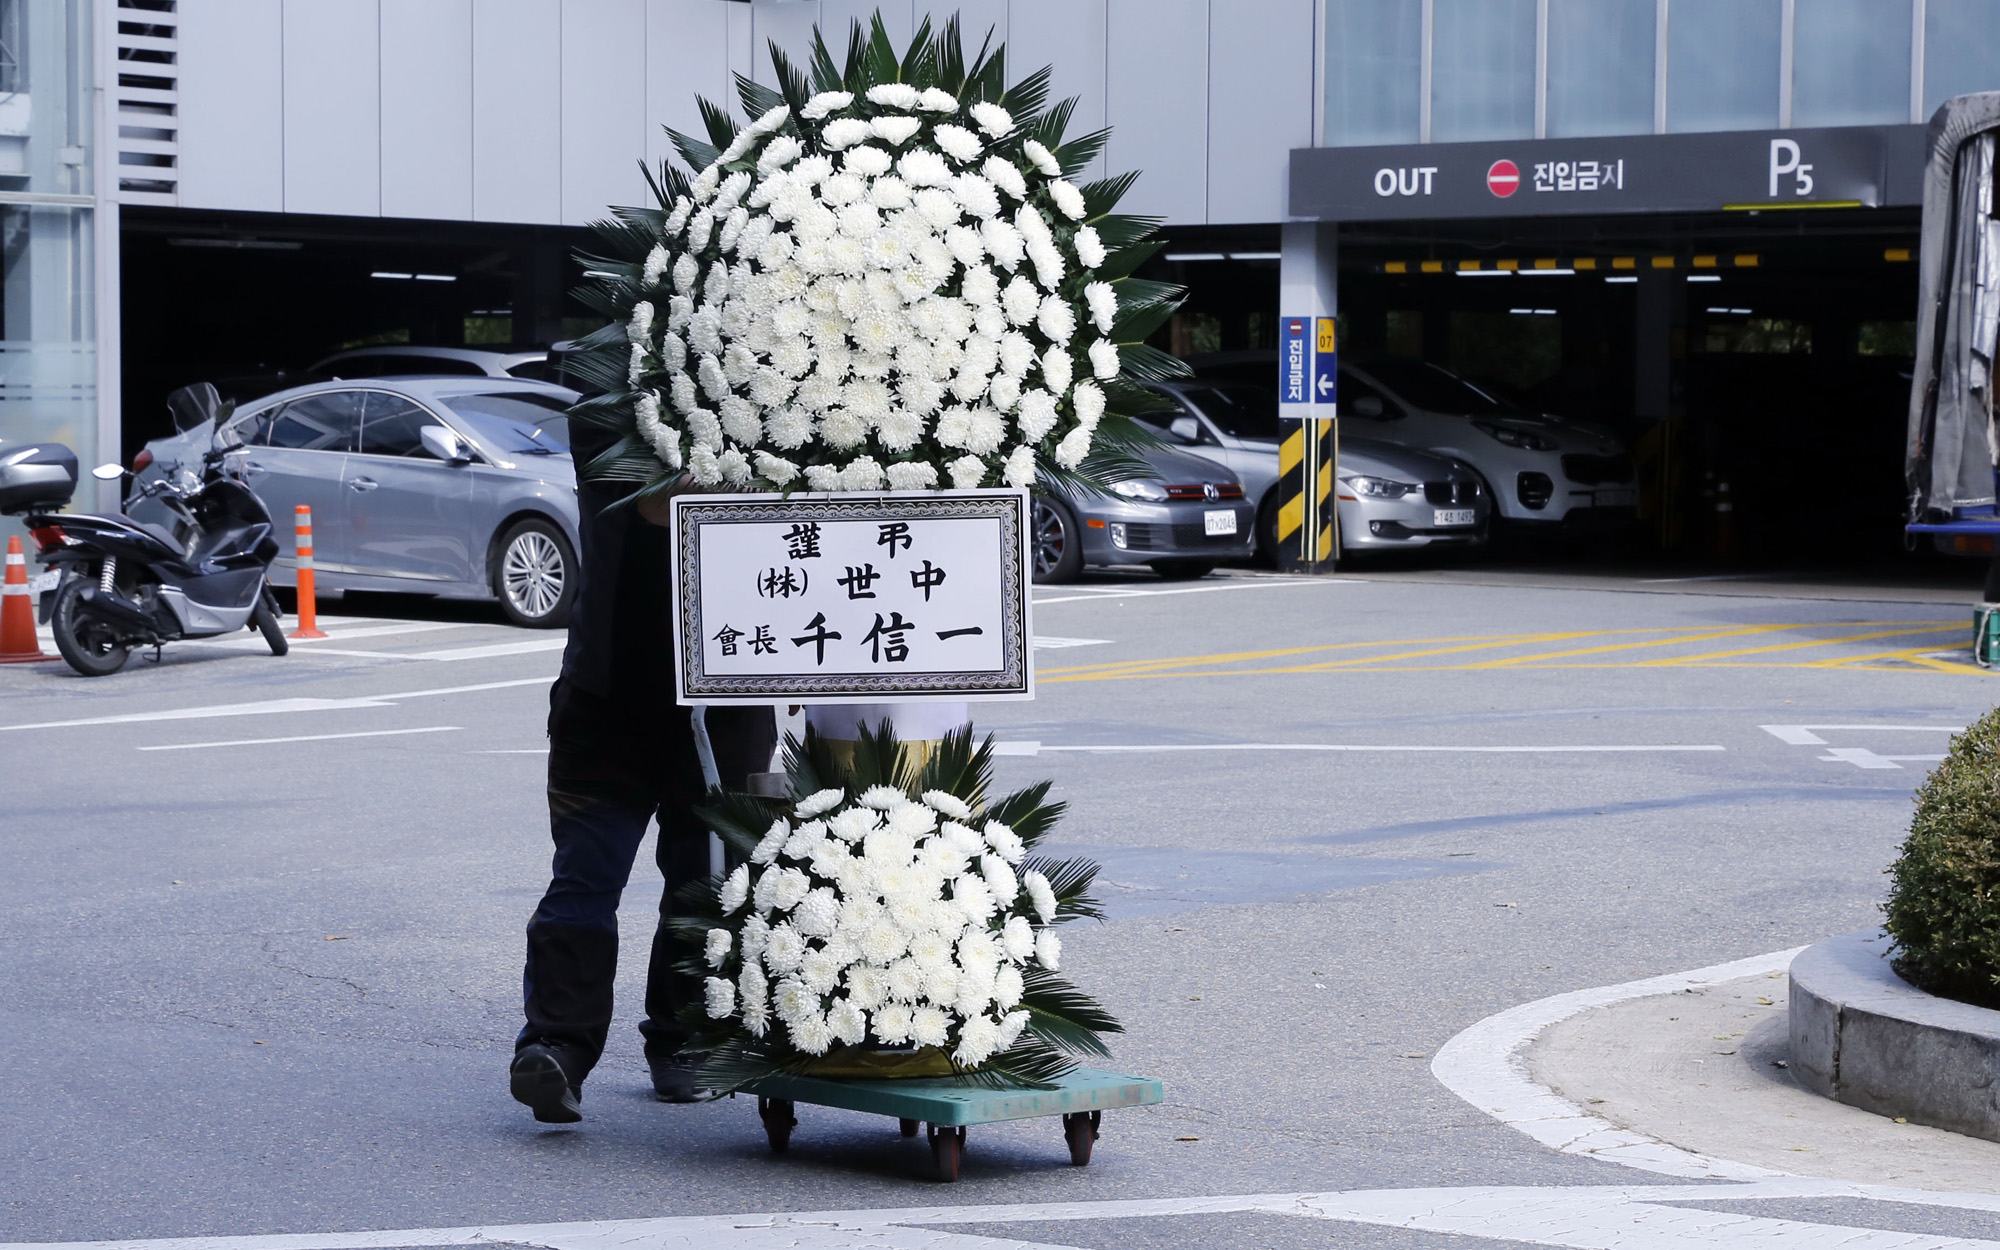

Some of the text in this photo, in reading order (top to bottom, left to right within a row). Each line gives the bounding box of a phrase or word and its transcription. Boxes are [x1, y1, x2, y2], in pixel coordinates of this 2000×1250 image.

[1374, 167, 1438, 197] OUT
[1533, 159, 1624, 192] 진입금지
[1769, 138, 1814, 197] P5
[1319, 335, 1332, 348] 07
[1288, 338, 1304, 401] 진입금지
[782, 522, 913, 560] 謹弔
